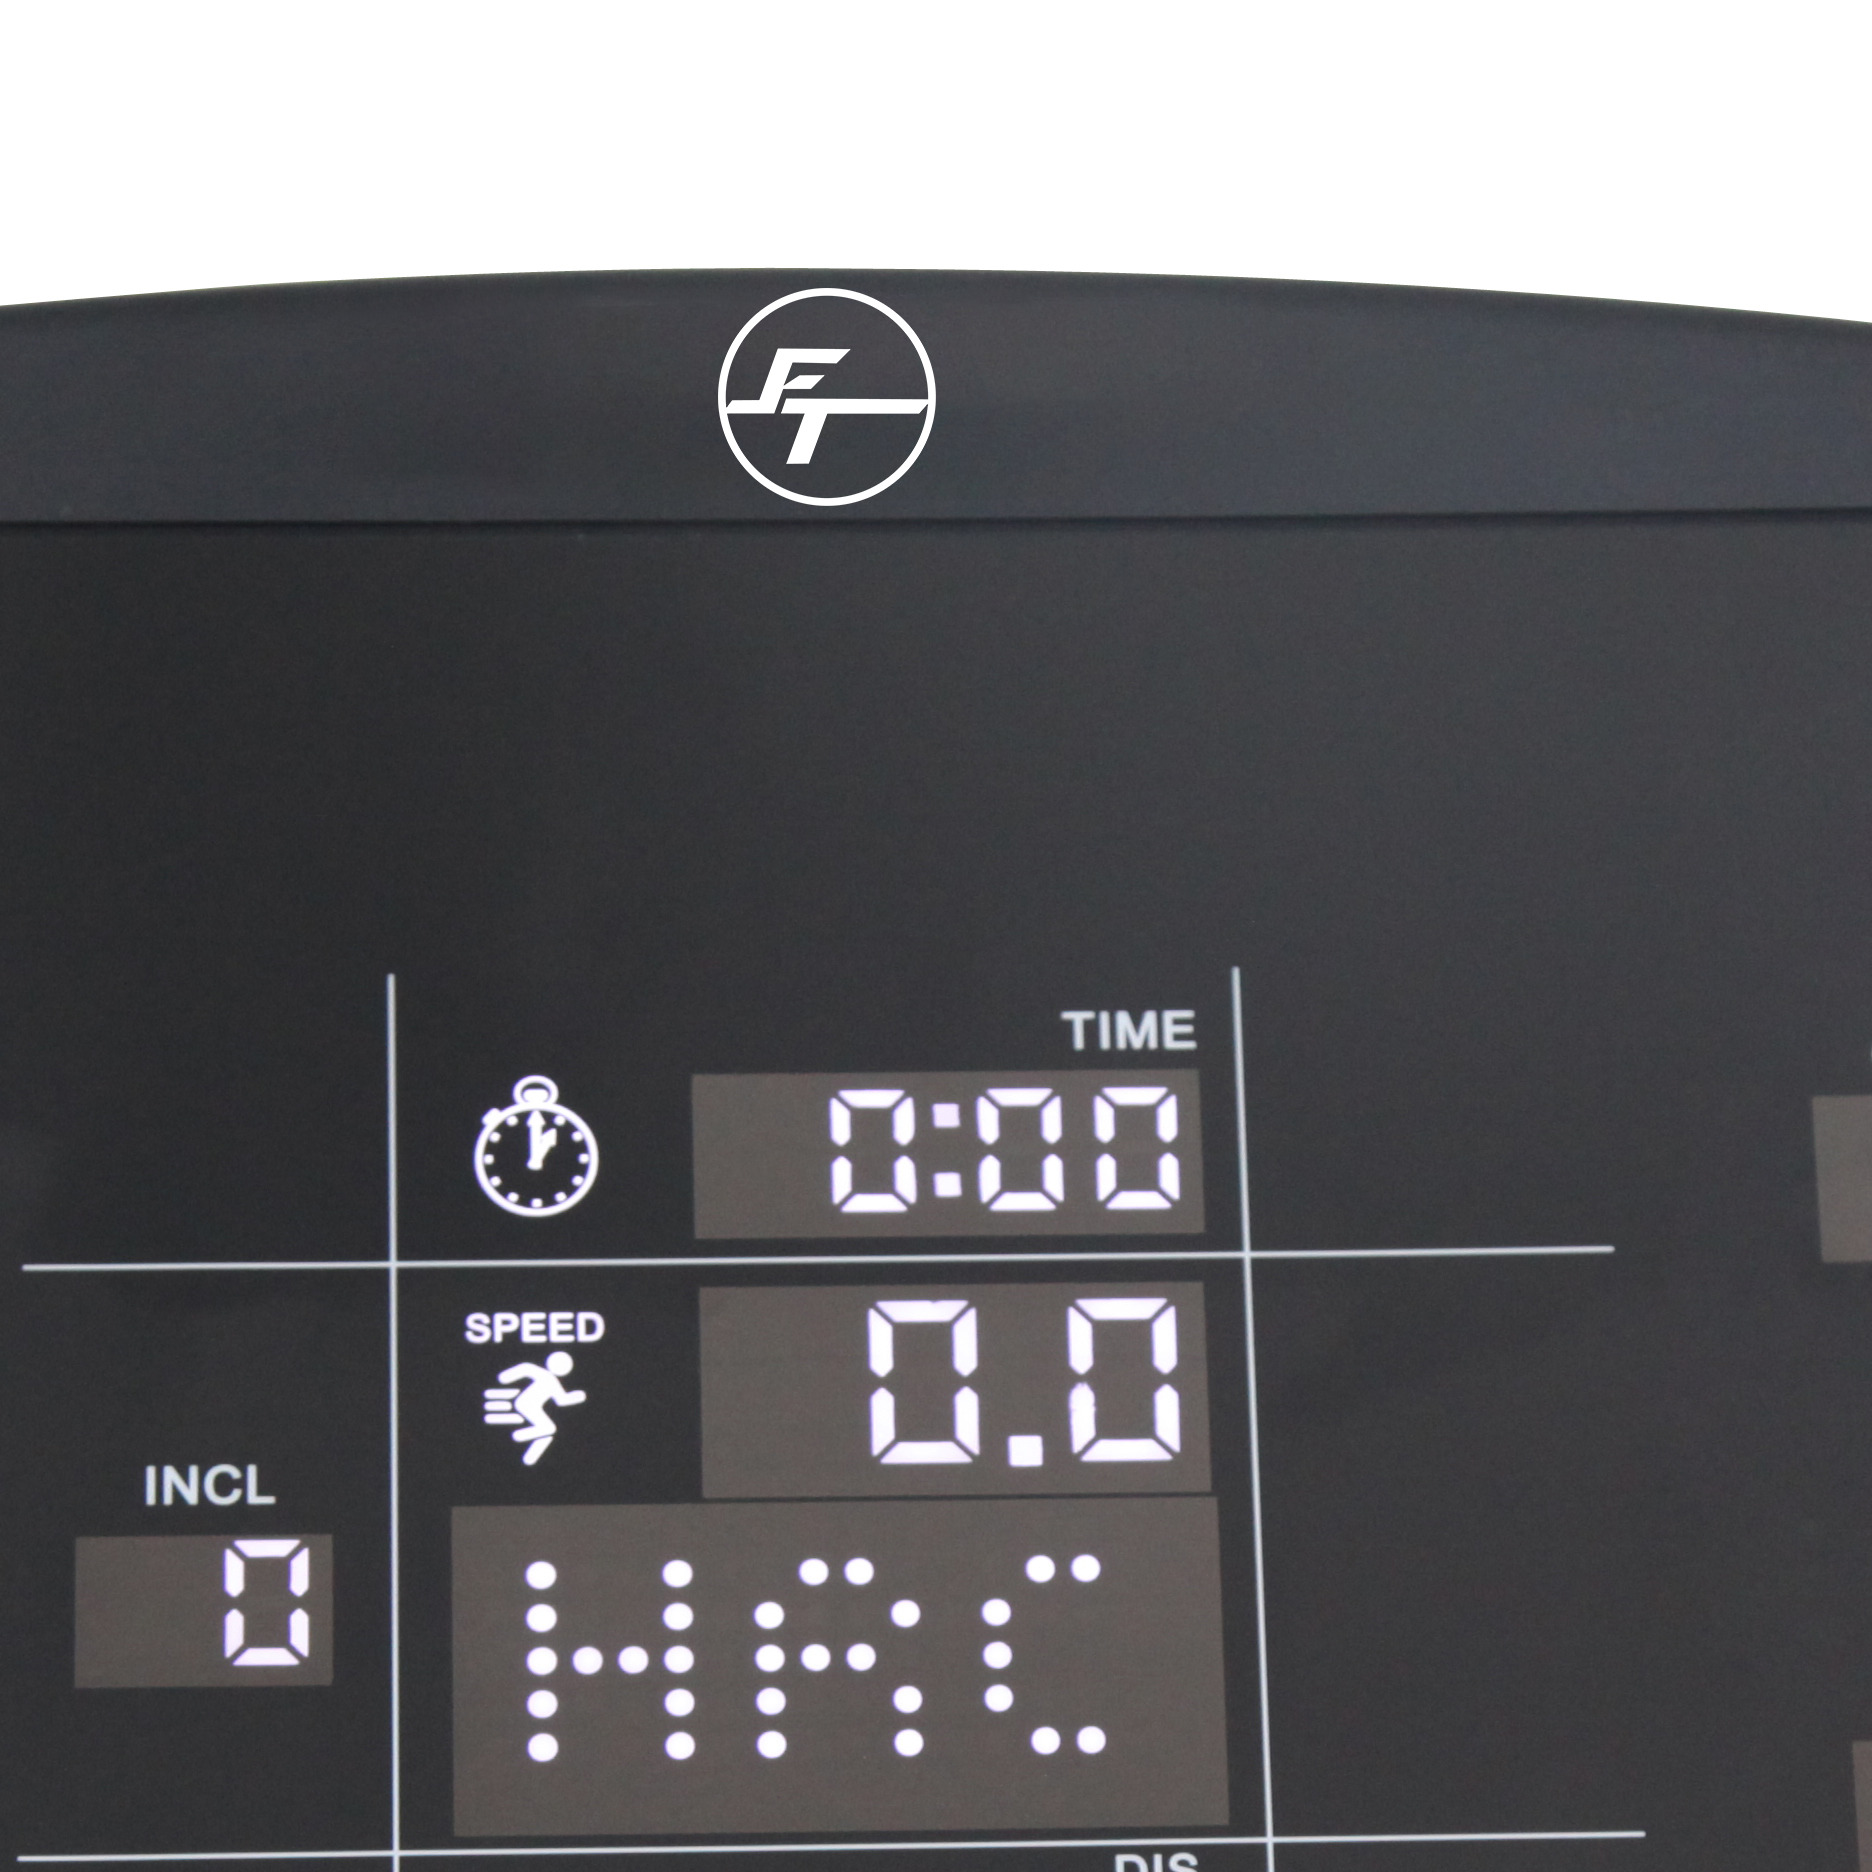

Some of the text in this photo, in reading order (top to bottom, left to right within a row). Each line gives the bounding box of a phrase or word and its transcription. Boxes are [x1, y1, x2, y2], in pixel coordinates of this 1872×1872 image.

[1059, 1008, 1198, 1052] TIME
[828, 1085, 1182, 1215] 0:00
[463, 1310, 607, 1346] SPEED
[866, 1296, 1182, 1466] 0.0
[145, 1462, 277, 1507] INCL
[223, 1538, 311, 1667] 0
